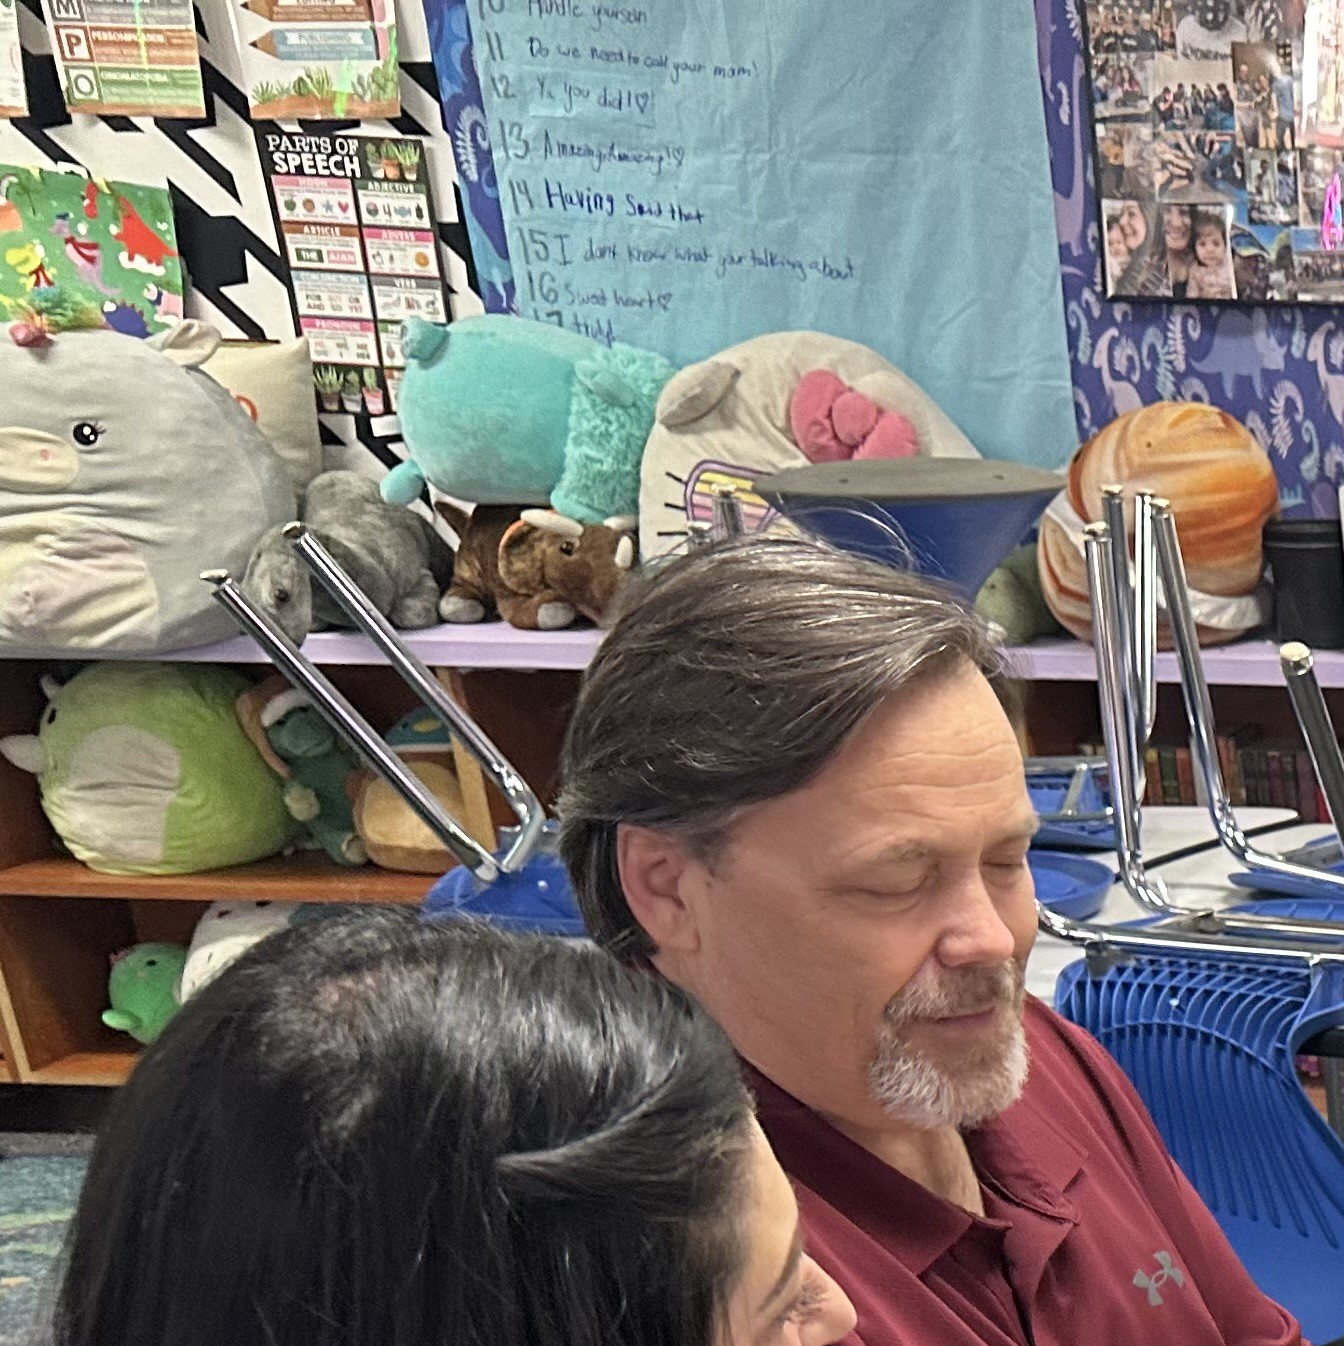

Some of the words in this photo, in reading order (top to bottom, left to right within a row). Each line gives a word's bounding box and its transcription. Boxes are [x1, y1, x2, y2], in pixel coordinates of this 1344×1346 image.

[528, 36, 549, 58] Do
[265, 134, 332, 153] PARTS
[335, 138, 359, 155] OF
[499, 119, 530, 161] 13
[272, 152, 361, 178] SPEECH
[509, 178, 535, 216] 14
[544, 177, 615, 217] Having
[517, 226, 550, 266] 15
[527, 270, 560, 306] 16
